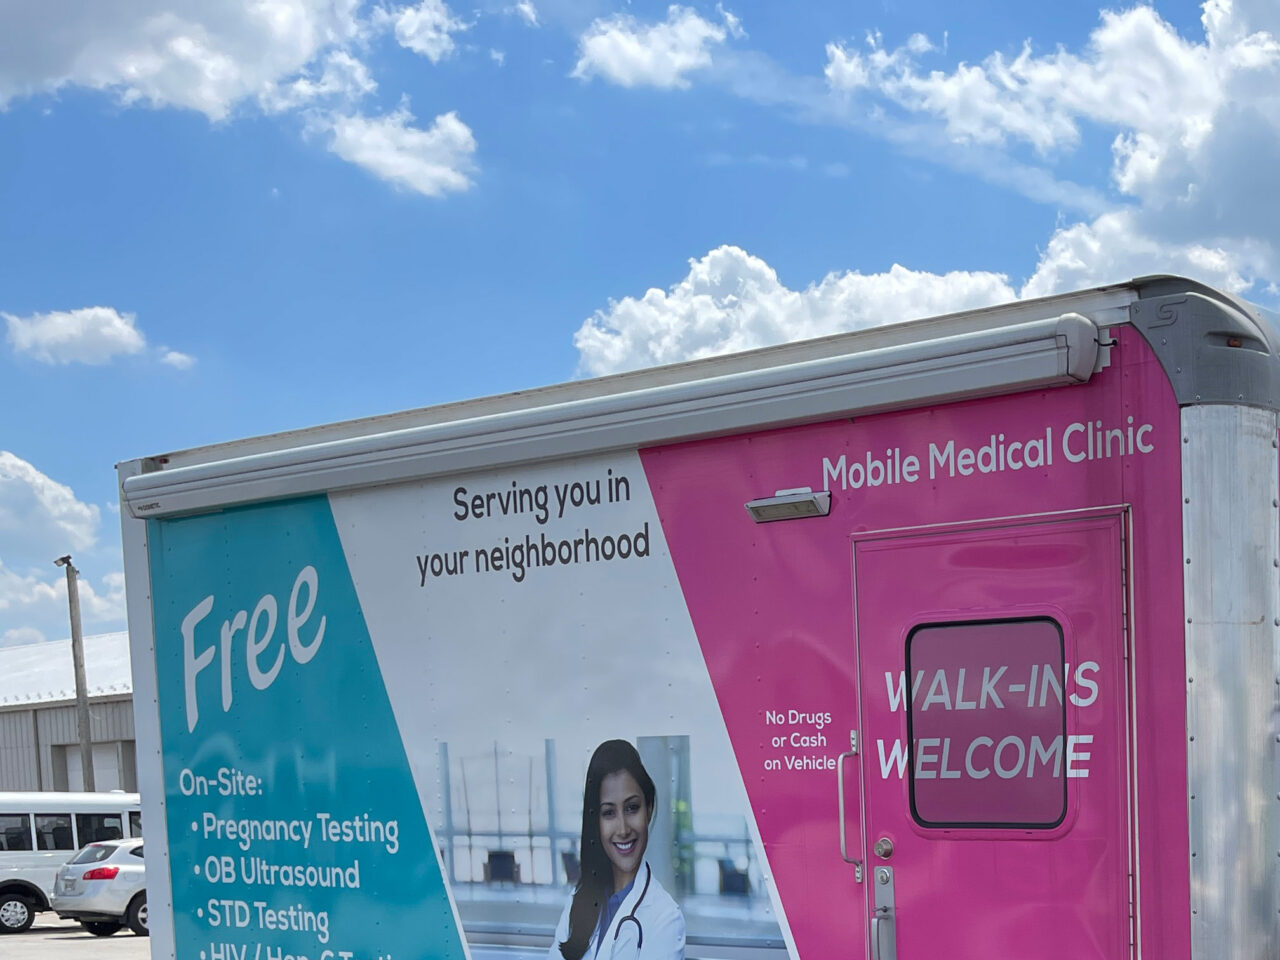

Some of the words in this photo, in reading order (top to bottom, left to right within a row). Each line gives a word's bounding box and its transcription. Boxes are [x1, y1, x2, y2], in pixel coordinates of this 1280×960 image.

[822, 449, 919, 492] Mobile
[928, 427, 1053, 480] Medical
[1062, 416, 1154, 463] Clinic
[453, 481, 549, 525] Serving
[554, 480, 600, 518] you
[607, 469, 631, 503] in
[416, 550, 468, 587] your
[475, 522, 650, 582] neighborhood
[181, 565, 326, 734] Free
[885, 661, 1101, 712] WALK-INS
[766, 711, 784, 725] No
[788, 710, 832, 729] Drugs
[772, 735, 786, 748] or
[789, 733, 827, 748] Cash
[764, 758, 781, 771] on
[784, 755, 836, 771] Vehicle
[877, 734, 1094, 779] WELCOME
[179, 769, 263, 797] On-Site:
[203, 813, 312, 851] Pregnancy
[317, 813, 399, 853] Testing
[205, 855, 236, 885] OB
[242, 855, 360, 889] Ultrasound
[207, 899, 250, 928] STD
[254, 901, 329, 943] Testing
